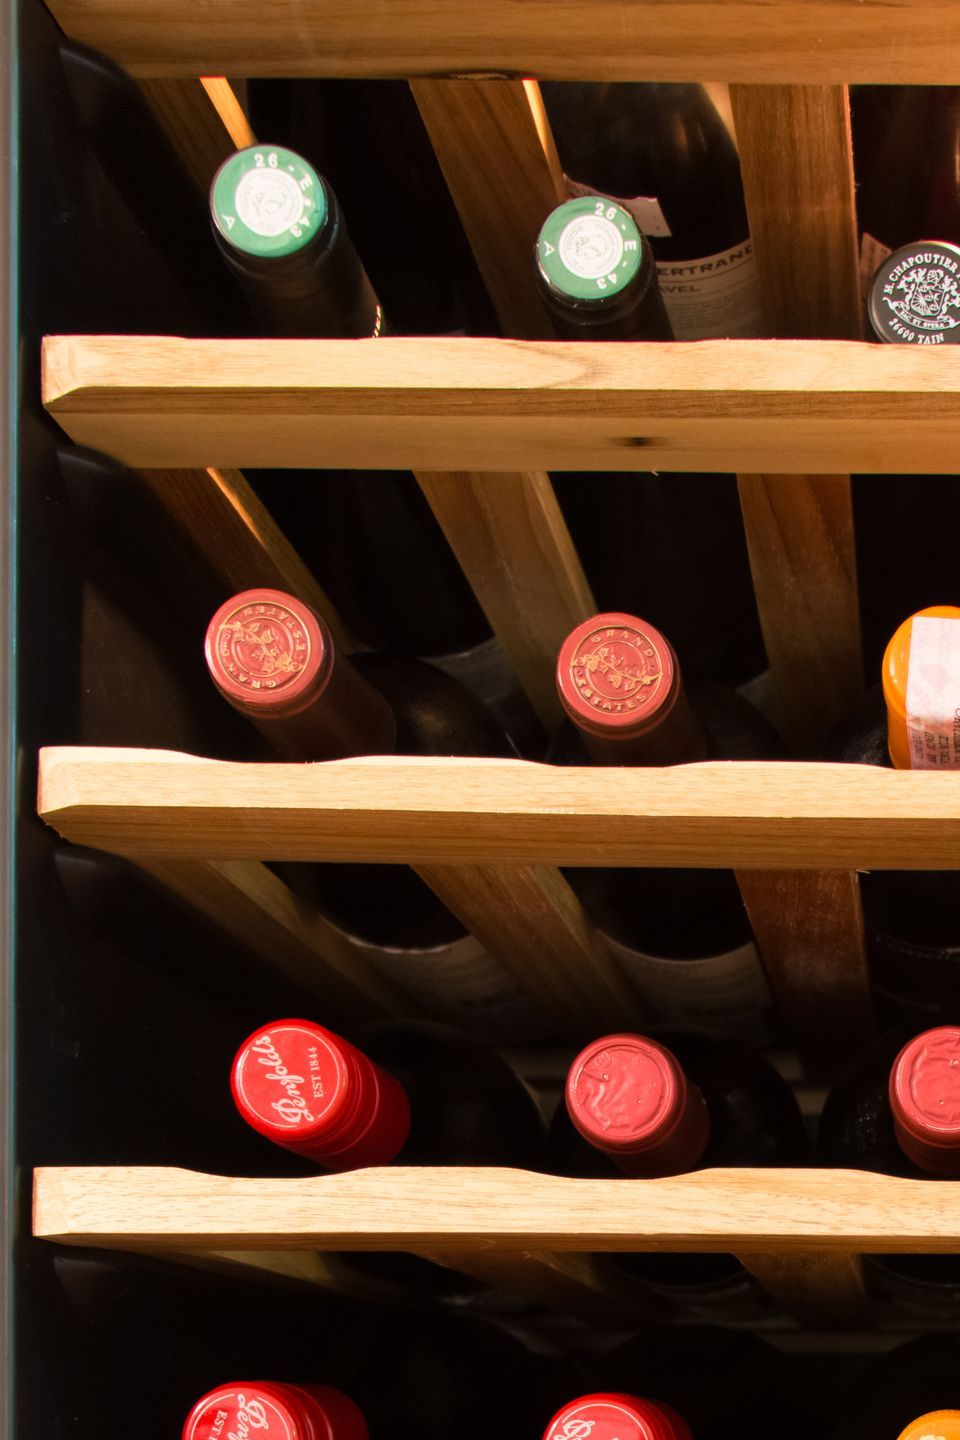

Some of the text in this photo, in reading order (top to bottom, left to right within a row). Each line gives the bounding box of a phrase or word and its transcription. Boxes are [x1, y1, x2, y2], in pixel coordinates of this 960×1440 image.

[254, 152, 278, 168] 26
[300, 170, 313, 190] E
[594, 202, 616, 219] 26
[222, 214, 236, 230] A
[544, 241, 555, 256] A
[624, 240, 637, 251] E
[889, 252, 958, 282] CHAPOUTIER
[597, 272, 617, 289] 43
[917, 333, 945, 344] TAIN
[576, 629, 654, 711] GRAND ESTATES
[251, 1035, 315, 1123] Penfolds
[307, 1046, 324, 1099] EST 1844
[214, 1409, 228, 1436] EST
